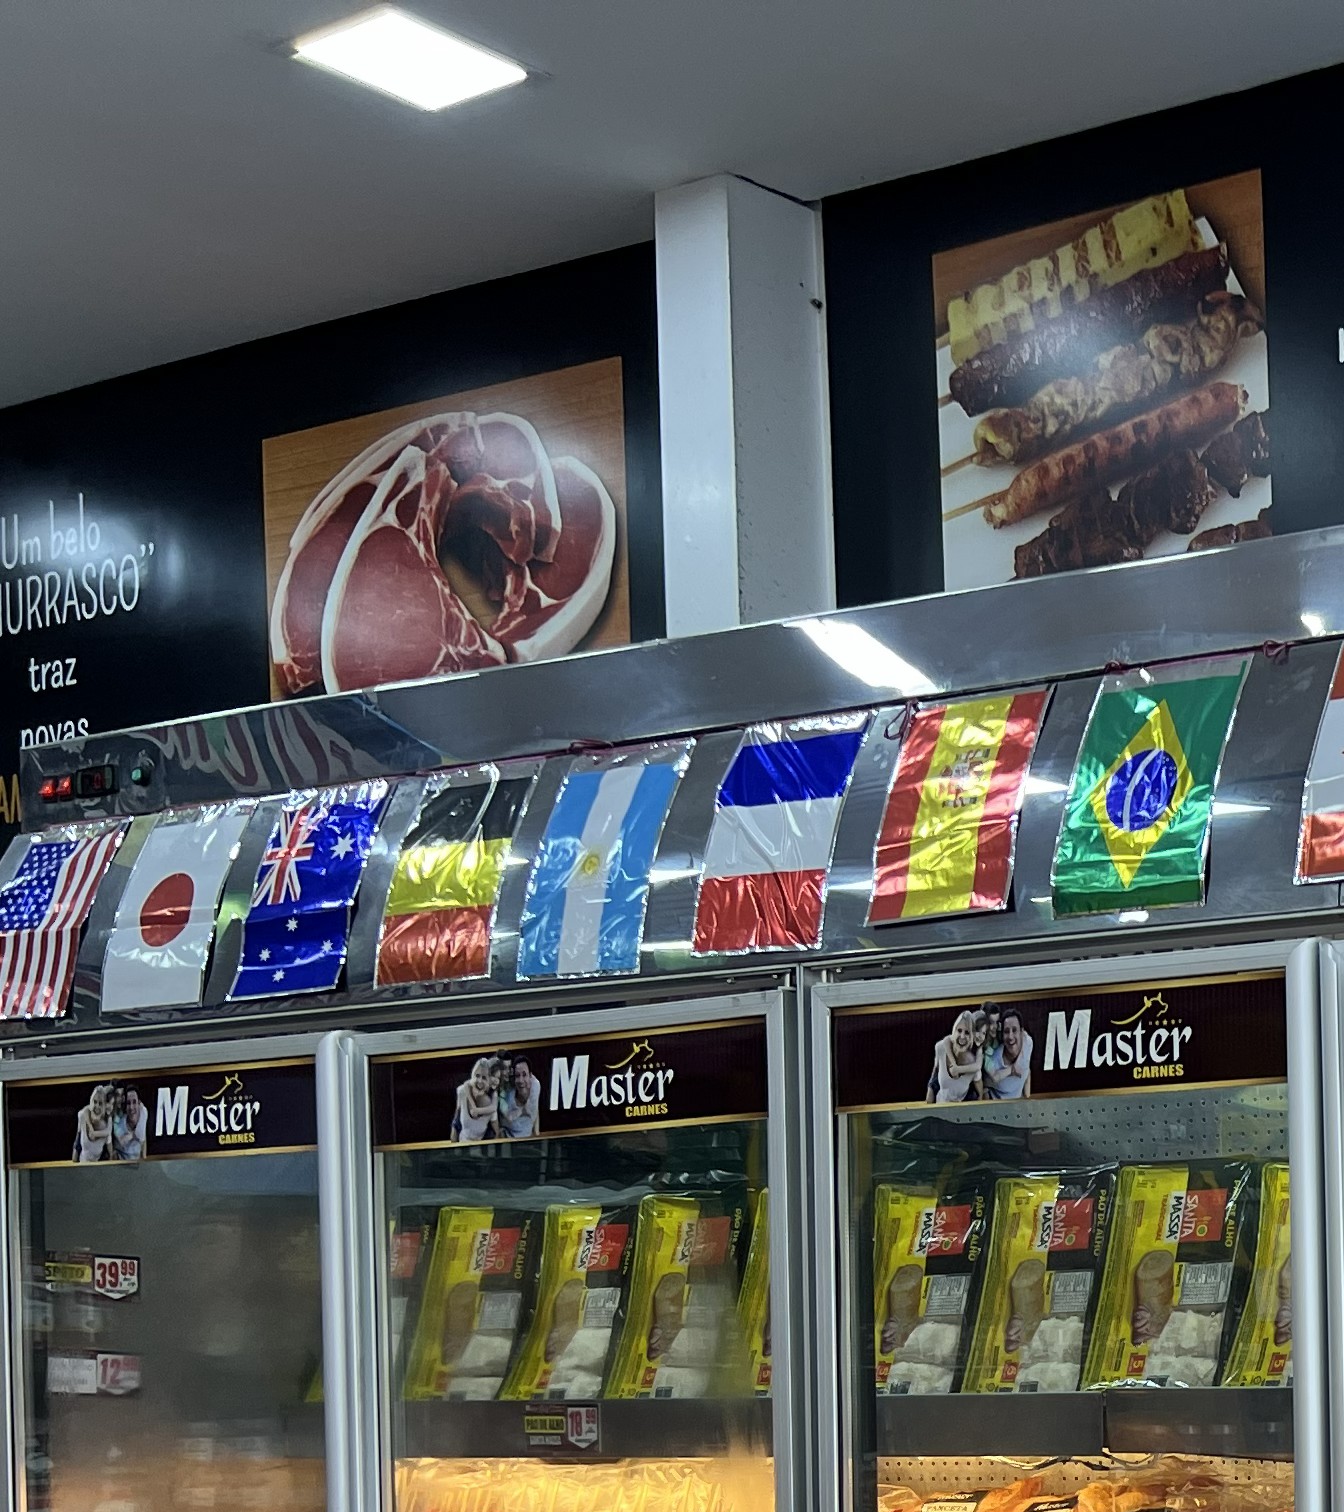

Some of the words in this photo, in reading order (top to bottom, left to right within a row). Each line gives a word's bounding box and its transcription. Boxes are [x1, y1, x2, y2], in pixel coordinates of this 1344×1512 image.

[1, 514, 41, 569] Um
[50, 493, 100, 560] belo
[0, 542, 154, 636] URRASCO”
[28, 658, 77, 691] traz
[21, 718, 88, 749] novas
[1044, 1009, 1192, 1071] Master
[550, 1055, 674, 1110] Master
[1133, 1064, 1184, 1079] CARNES
[155, 1086, 260, 1136] Master
[625, 1103, 668, 1117] CARNES
[219, 1133, 255, 1144] CARNES
[1180, 1194, 1199, 1237] SANTA
